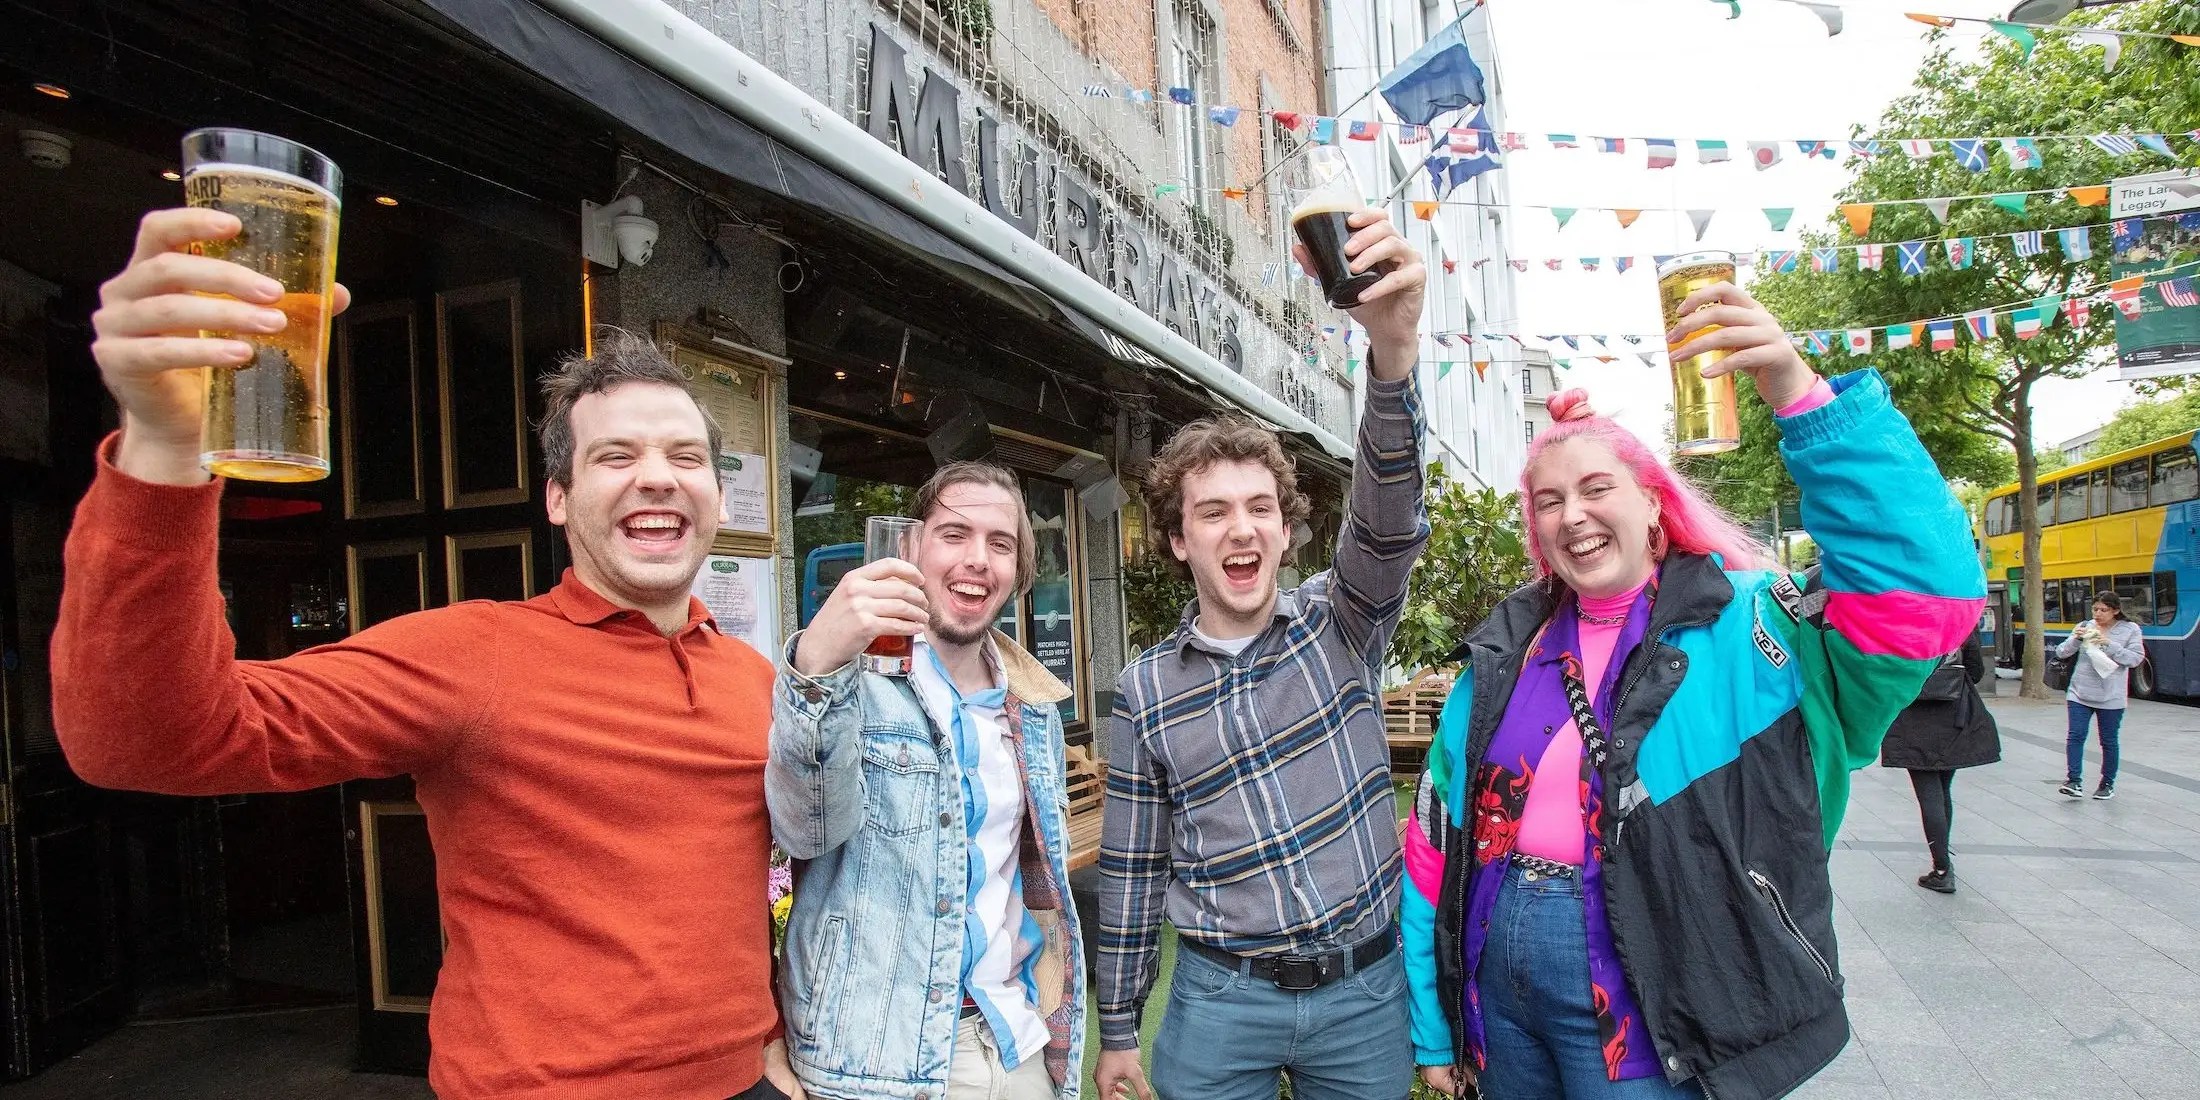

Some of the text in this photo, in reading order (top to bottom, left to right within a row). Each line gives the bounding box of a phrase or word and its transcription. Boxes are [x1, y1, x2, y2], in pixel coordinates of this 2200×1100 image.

[2121, 186, 2173, 199] The Lan
[2120, 199, 2168, 212] Legacy
[1037, 649, 1054, 657] SETTLED
[1043, 658, 1066, 667] MURRAYS
